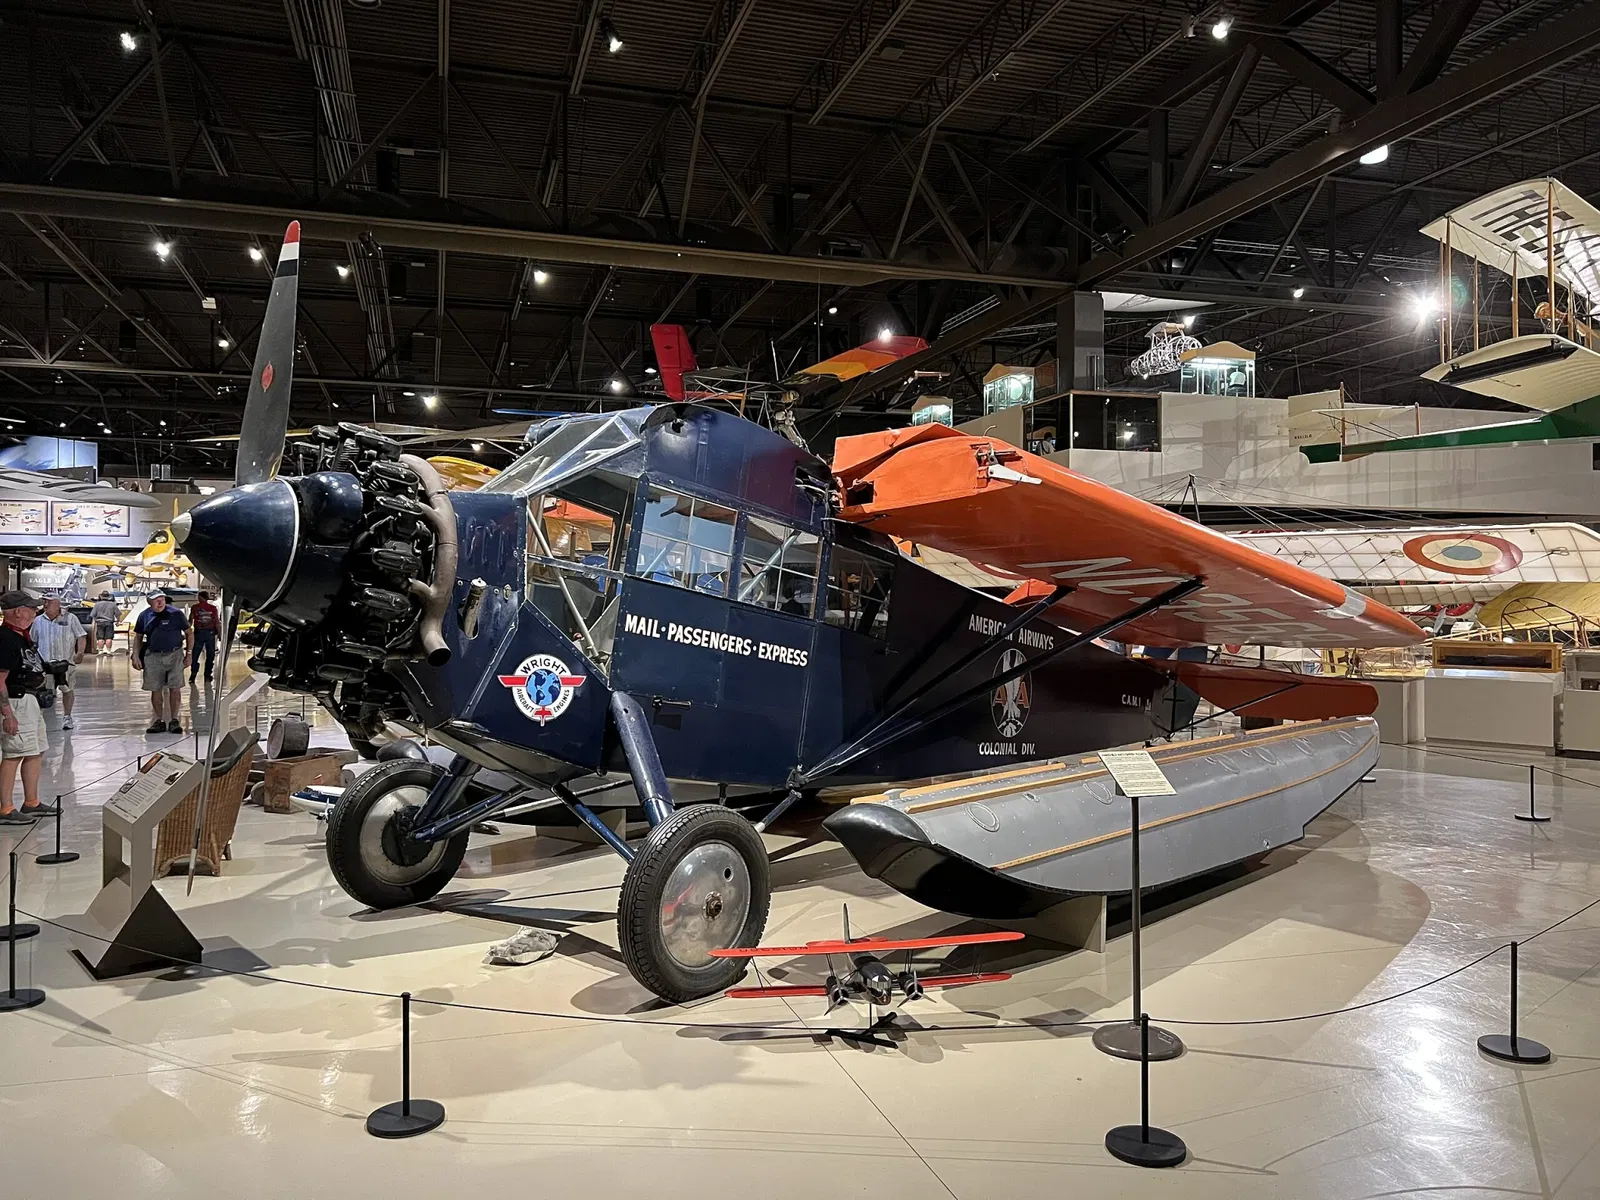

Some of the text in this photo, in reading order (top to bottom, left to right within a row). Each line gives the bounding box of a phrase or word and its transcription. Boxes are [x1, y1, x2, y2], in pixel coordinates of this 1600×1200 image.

[624, 613, 809, 667] MAIL PASSENGERS EXPRESS
[1018, 627, 1054, 650] AIRWAYS
[520, 658, 567, 675] WRIGHT
[516, 688, 570, 713] AIRCRAFT ENGINES
[979, 741, 1036, 755] COLONIAL DIV.
